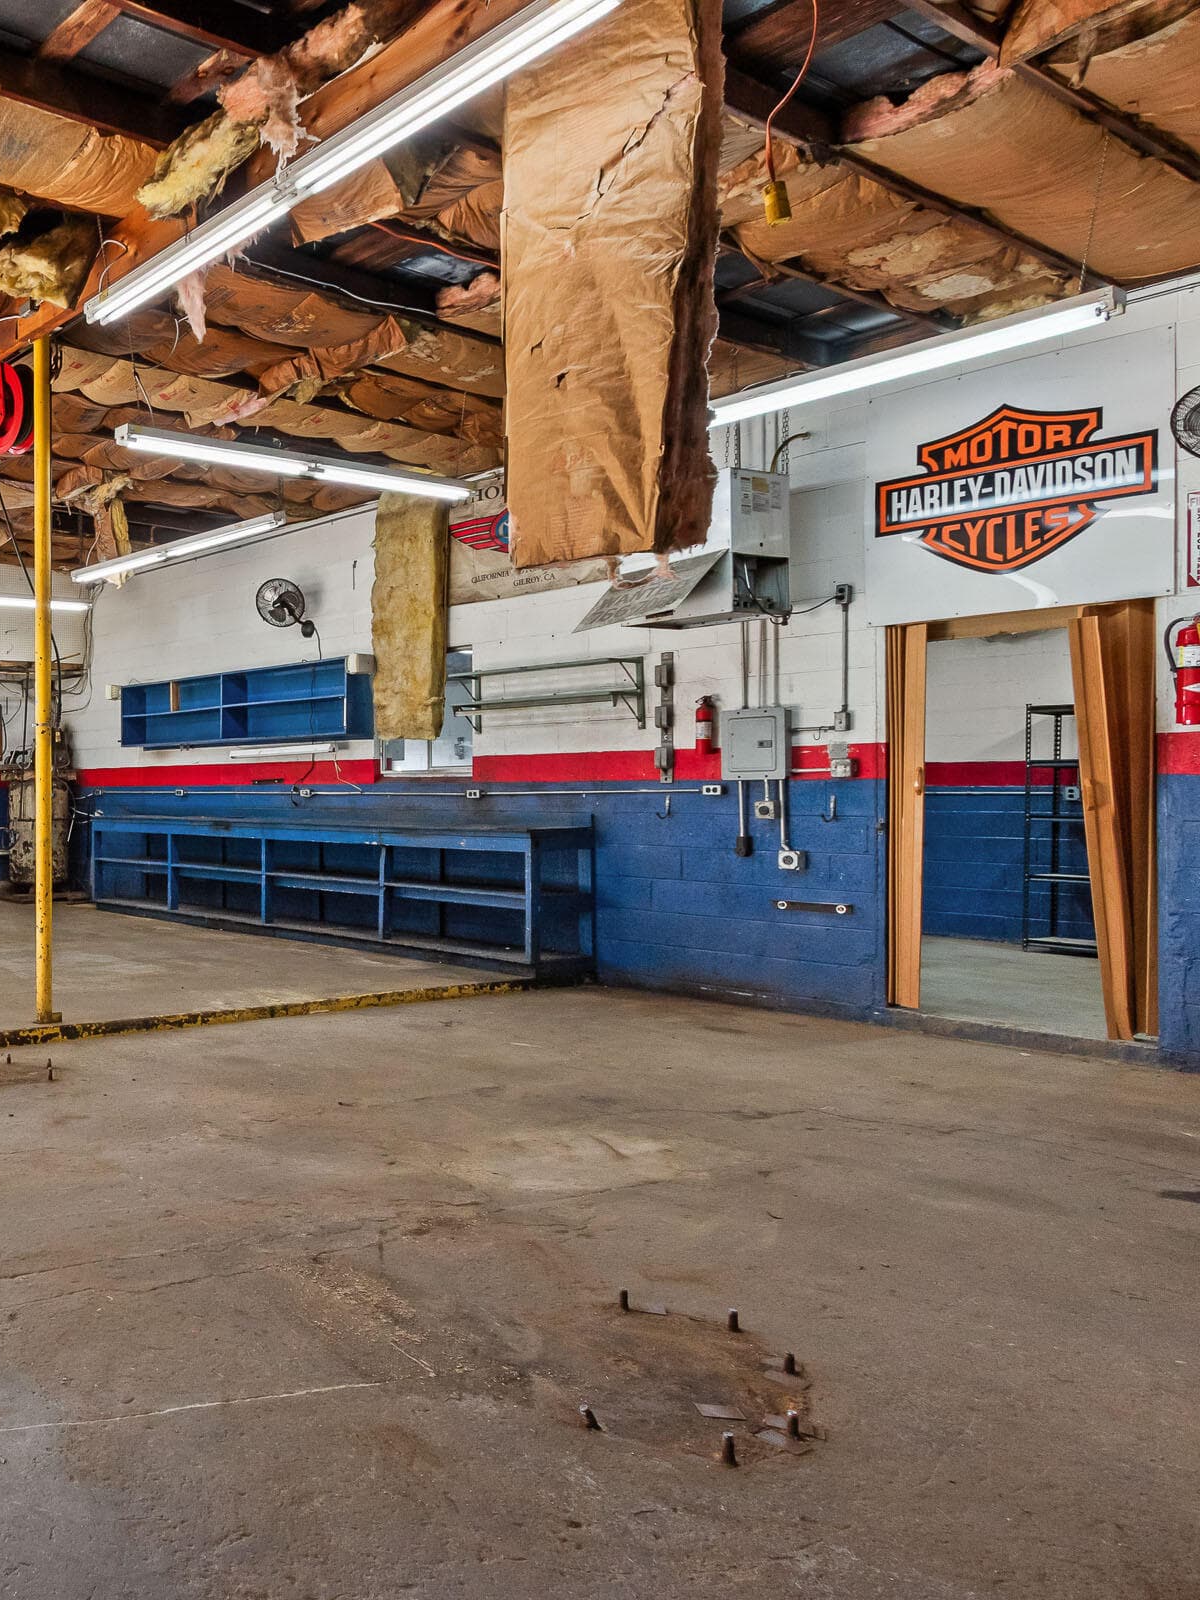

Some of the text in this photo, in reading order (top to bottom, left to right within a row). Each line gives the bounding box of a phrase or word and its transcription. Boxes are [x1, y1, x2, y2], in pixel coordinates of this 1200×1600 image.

[943, 420, 1073, 468] MOTOR
[891, 448, 1137, 522] HARLEY-DAVIDSON
[941, 504, 1070, 562] CYCLES
[471, 570, 510, 584] CALIFORNIA
[543, 573, 556, 581] CA
